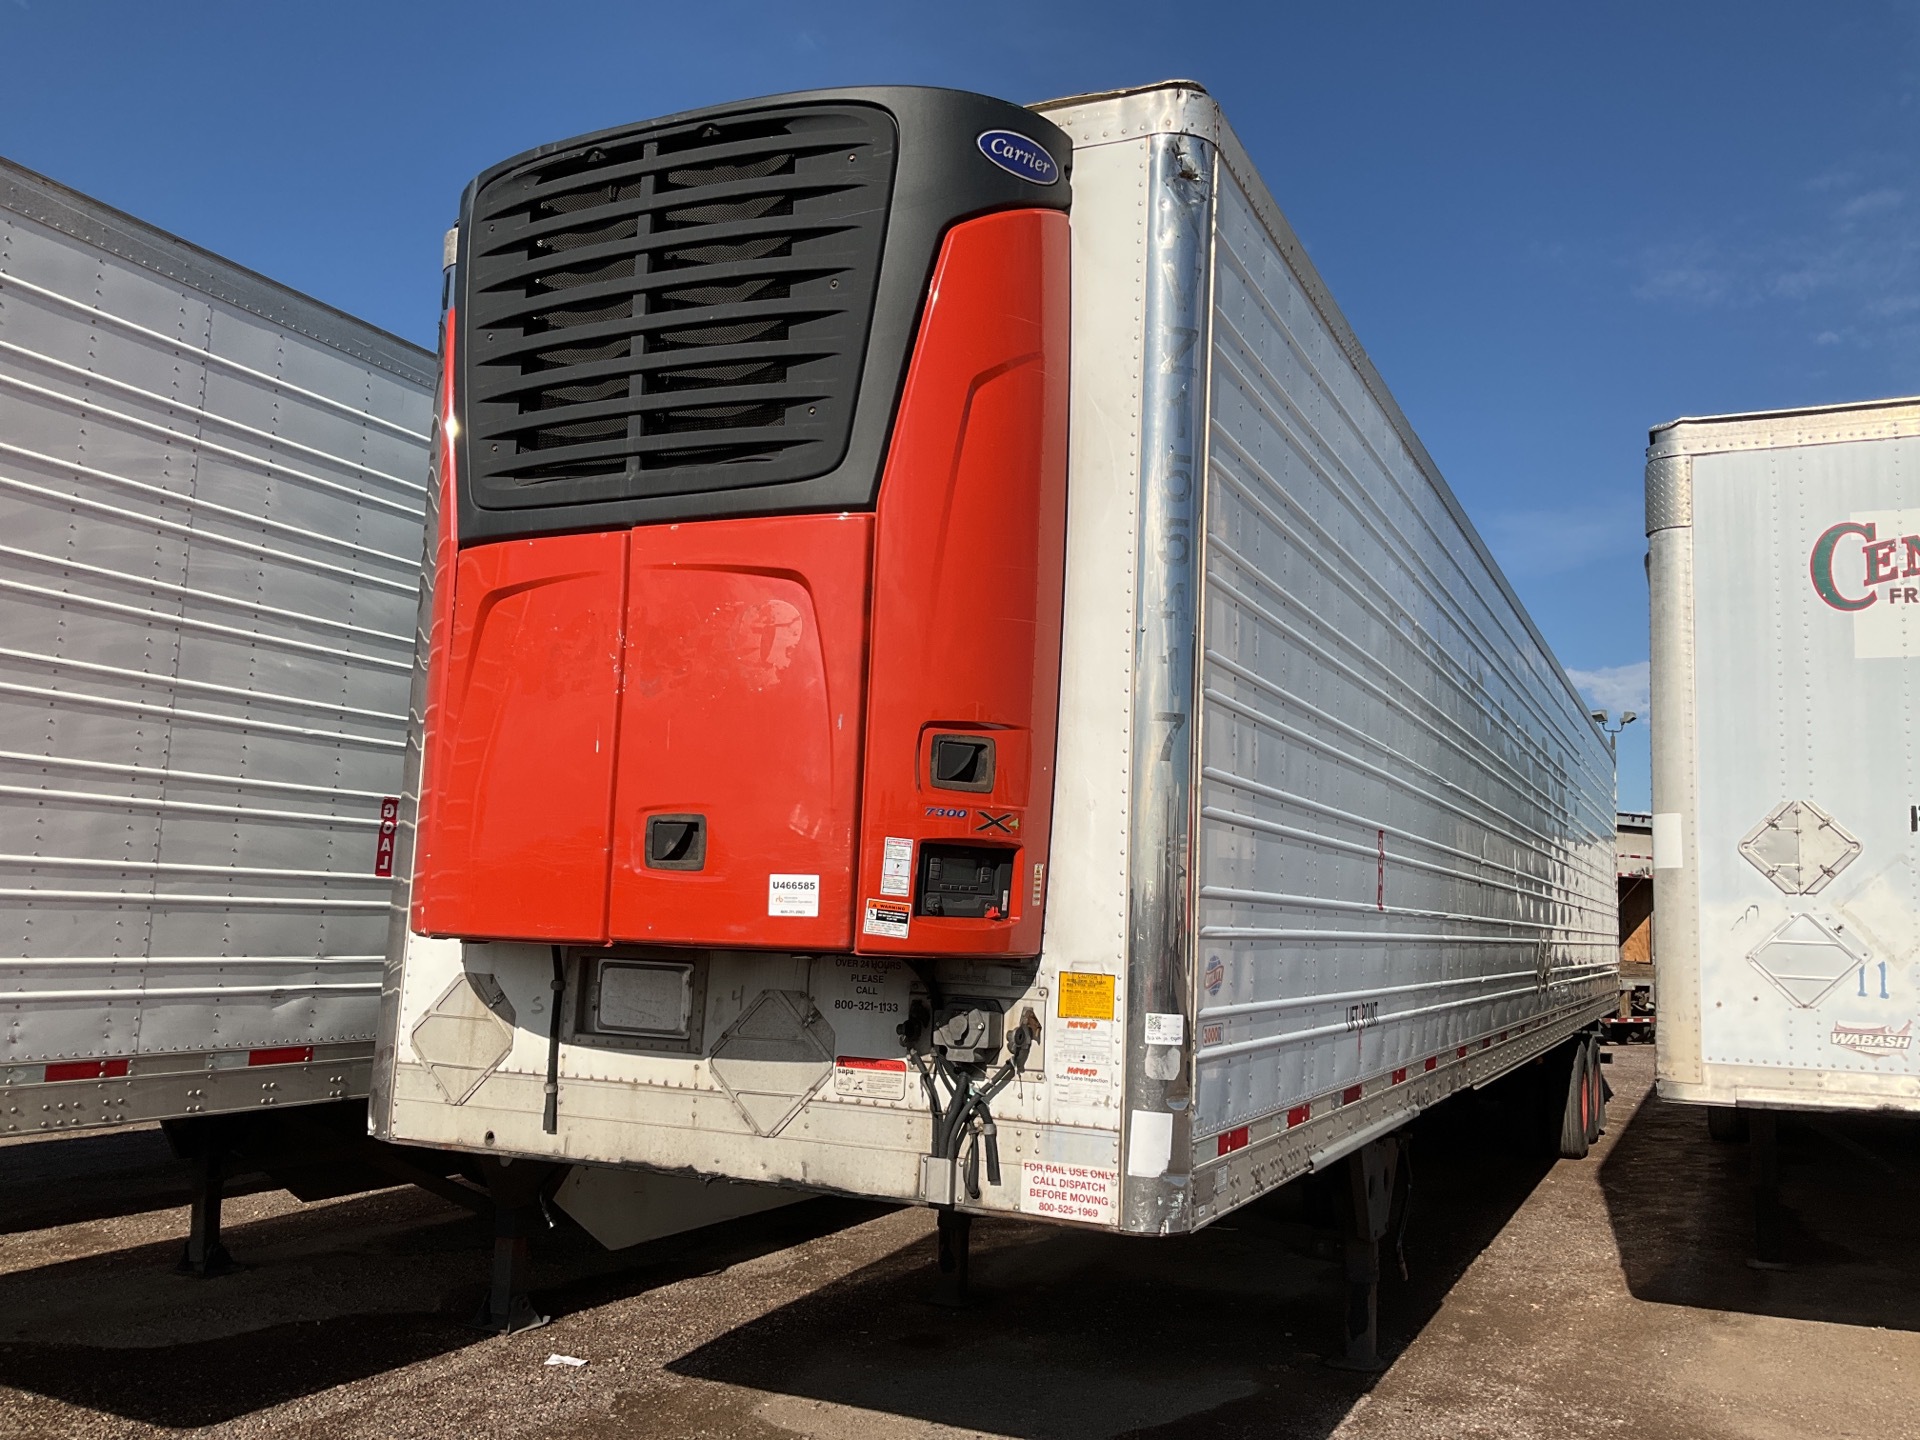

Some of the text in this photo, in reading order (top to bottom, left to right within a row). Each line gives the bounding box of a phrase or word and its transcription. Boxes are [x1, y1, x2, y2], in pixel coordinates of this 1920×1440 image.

[991, 138, 1051, 173] Carrier
[925, 806, 968, 819] 7300
[772, 881, 816, 890] U466585
[880, 903, 906, 911] WARNING
[835, 959, 902, 970] OVER 24 HOURS
[851, 973, 884, 984] PLEASE
[856, 986, 879, 995] CALL
[834, 999, 899, 1013] 800-321-1133
[1832, 1032, 1911, 1049] WABASH
[1056, 1073, 1071, 1081] Safety
[1084, 1076, 1109, 1084] Inspection
[1024, 1162, 1115, 1180] FOR RAIL USE ONLY
[1033, 1175, 1106, 1192] CALL DISPATCH
[1029, 1188, 1108, 1206] BEFORE MOVING
[1039, 1202, 1099, 1217] 800-525-1969
